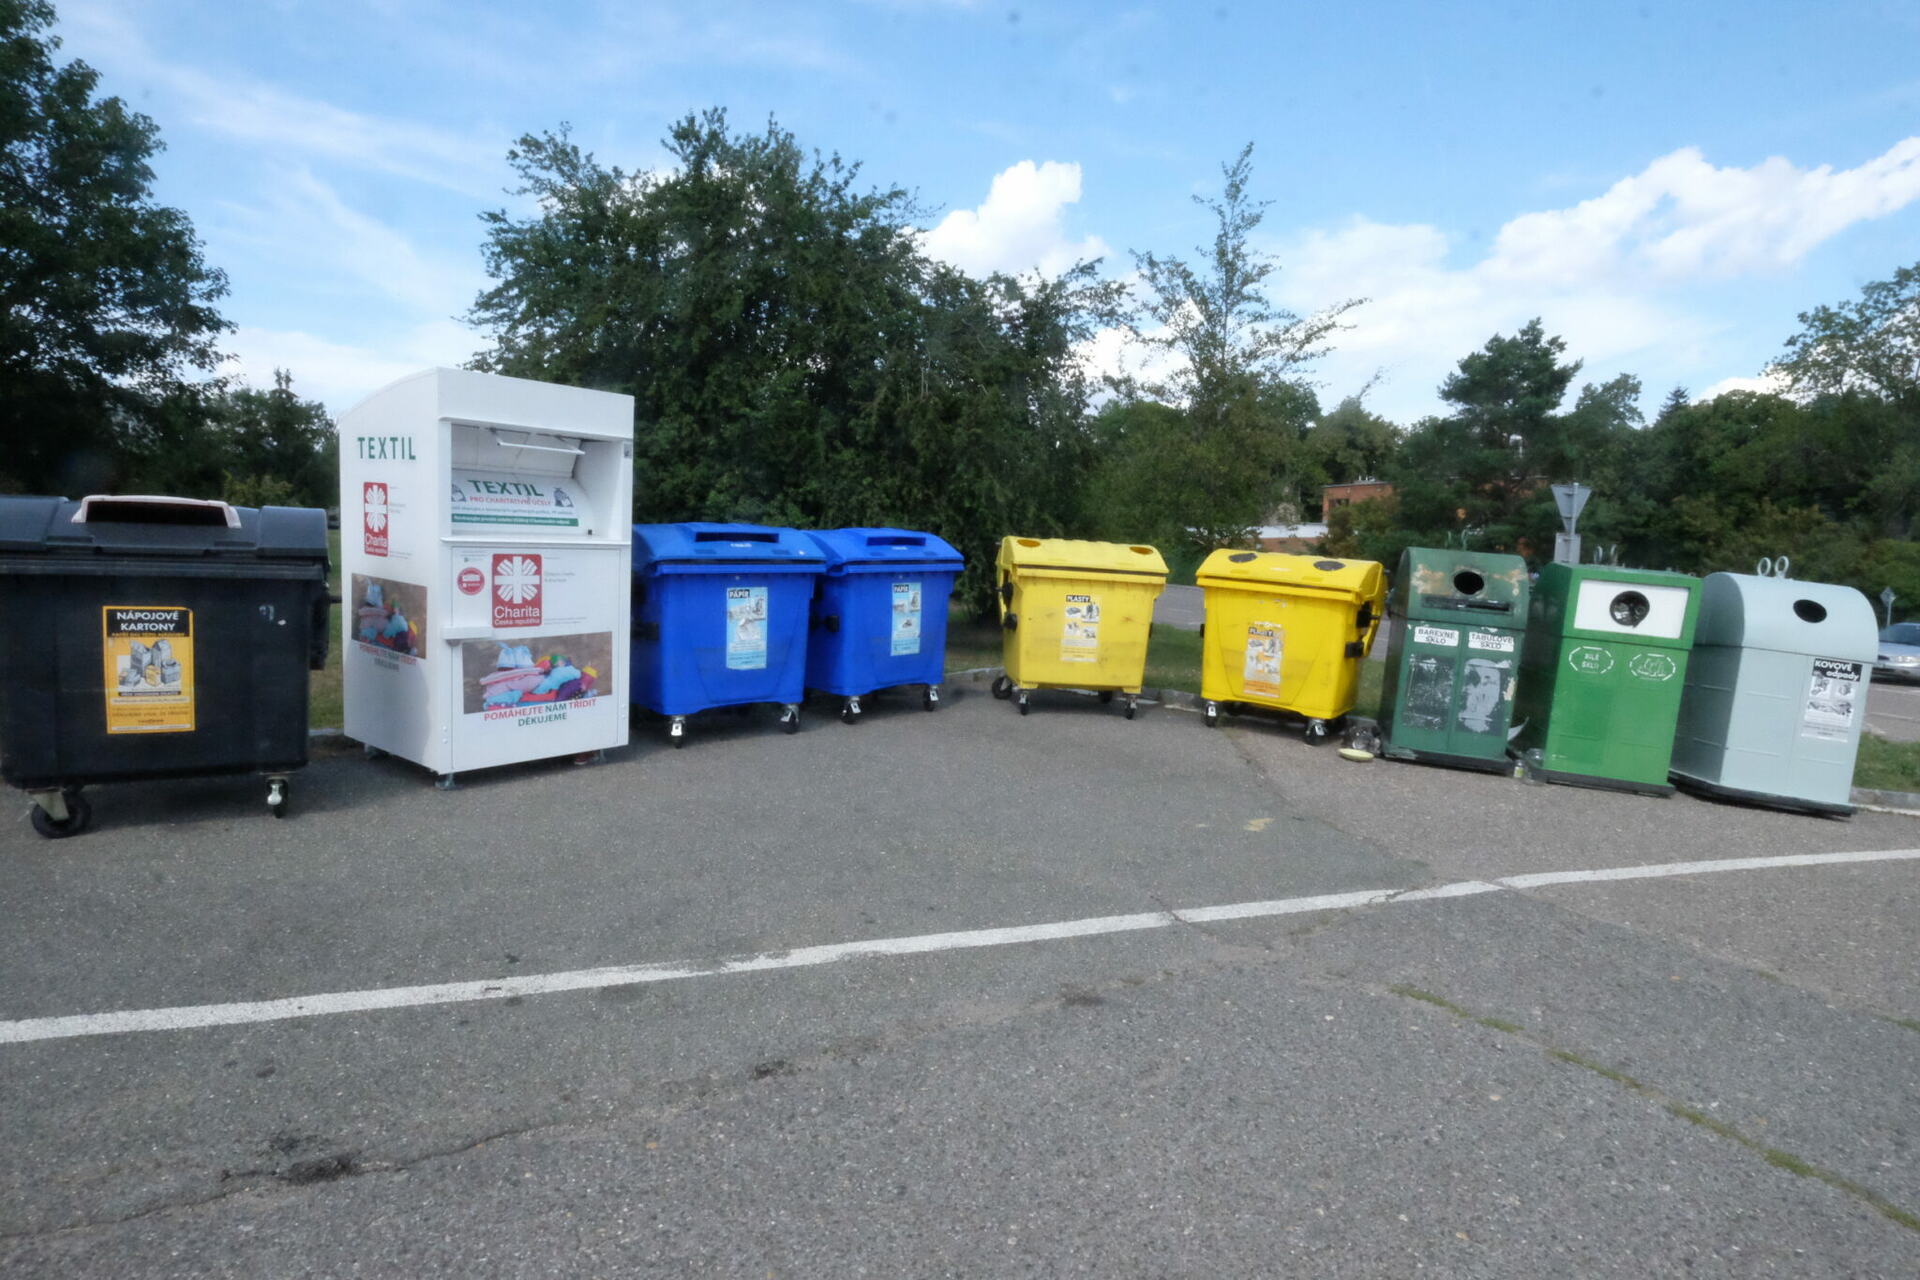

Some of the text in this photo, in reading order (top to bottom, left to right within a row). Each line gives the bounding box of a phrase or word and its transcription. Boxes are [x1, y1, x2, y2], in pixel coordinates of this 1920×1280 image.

[357, 437, 416, 460] TEXTIL
[467, 480, 544, 497] TEXTIL
[1066, 595, 1091, 603] PLASTY
[116, 610, 180, 621] NÁPOJOVÉ
[494, 606, 540, 619] Charita
[120, 623, 176, 631] KARTONY
[1425, 636, 1446, 645] SKLO
[1480, 641, 1502, 649] SKLO
[1826, 670, 1860, 681] odpady
